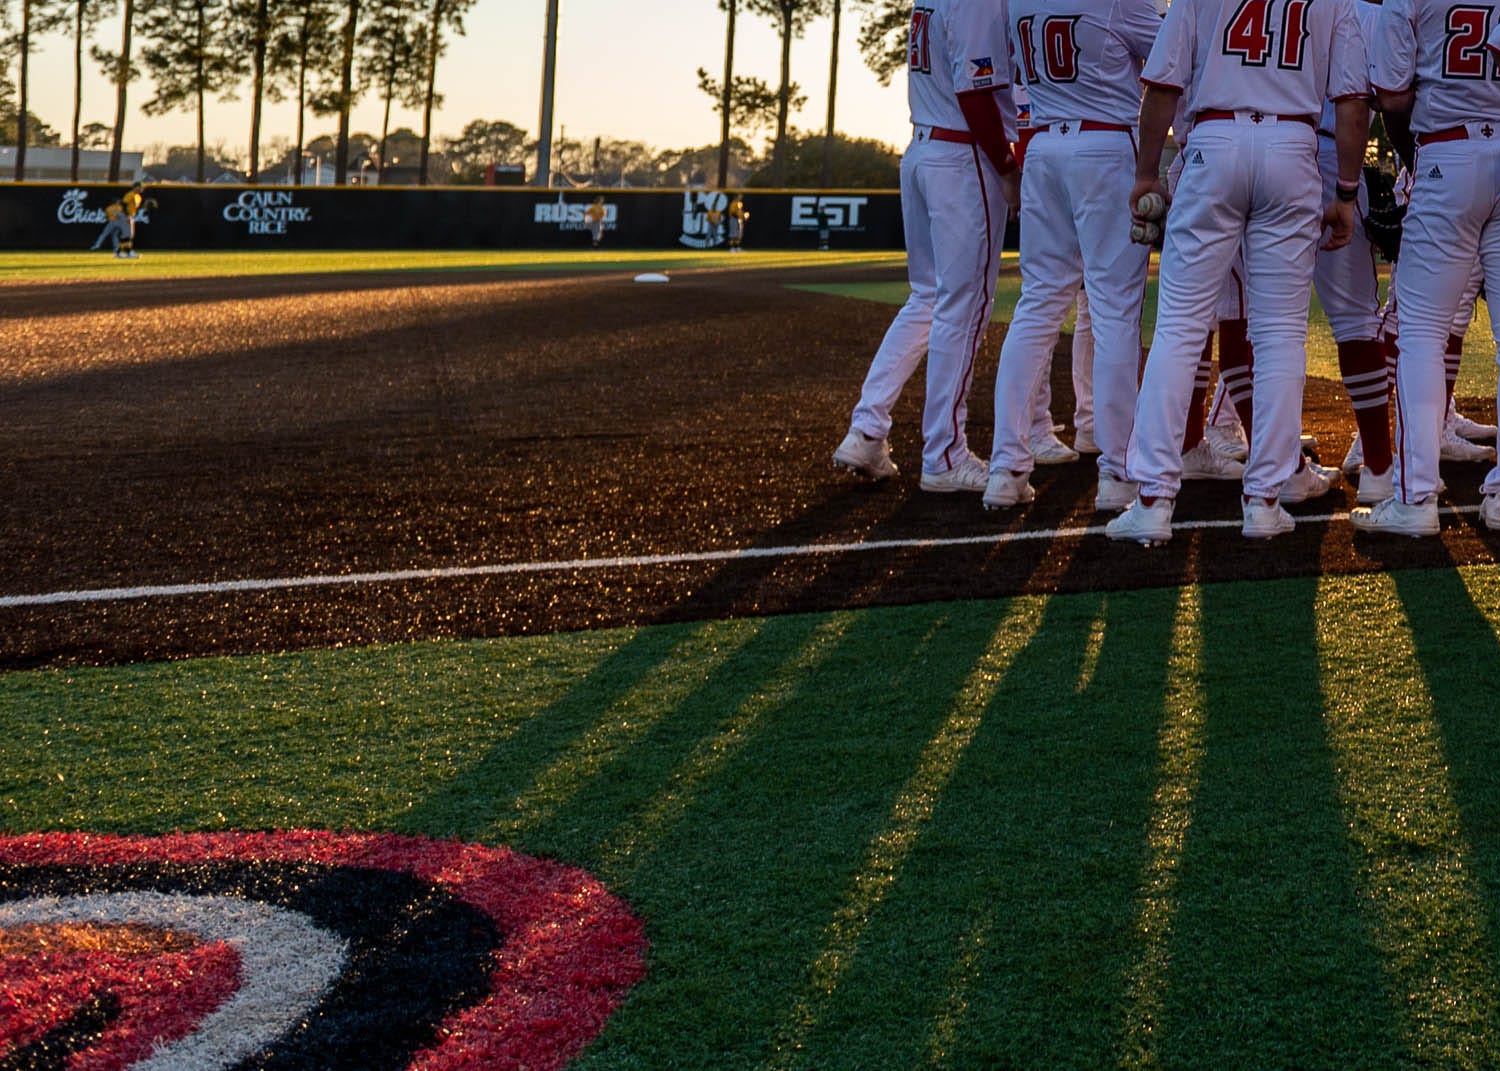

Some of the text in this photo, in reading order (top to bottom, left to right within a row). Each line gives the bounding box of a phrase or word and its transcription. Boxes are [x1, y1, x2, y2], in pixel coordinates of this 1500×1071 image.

[1017, 14, 1083, 84] 10
[238, 190, 293, 208] CAJUN
[534, 199, 618, 223] RUSO
[791, 196, 868, 226] EST
[248, 220, 287, 235] RICE
